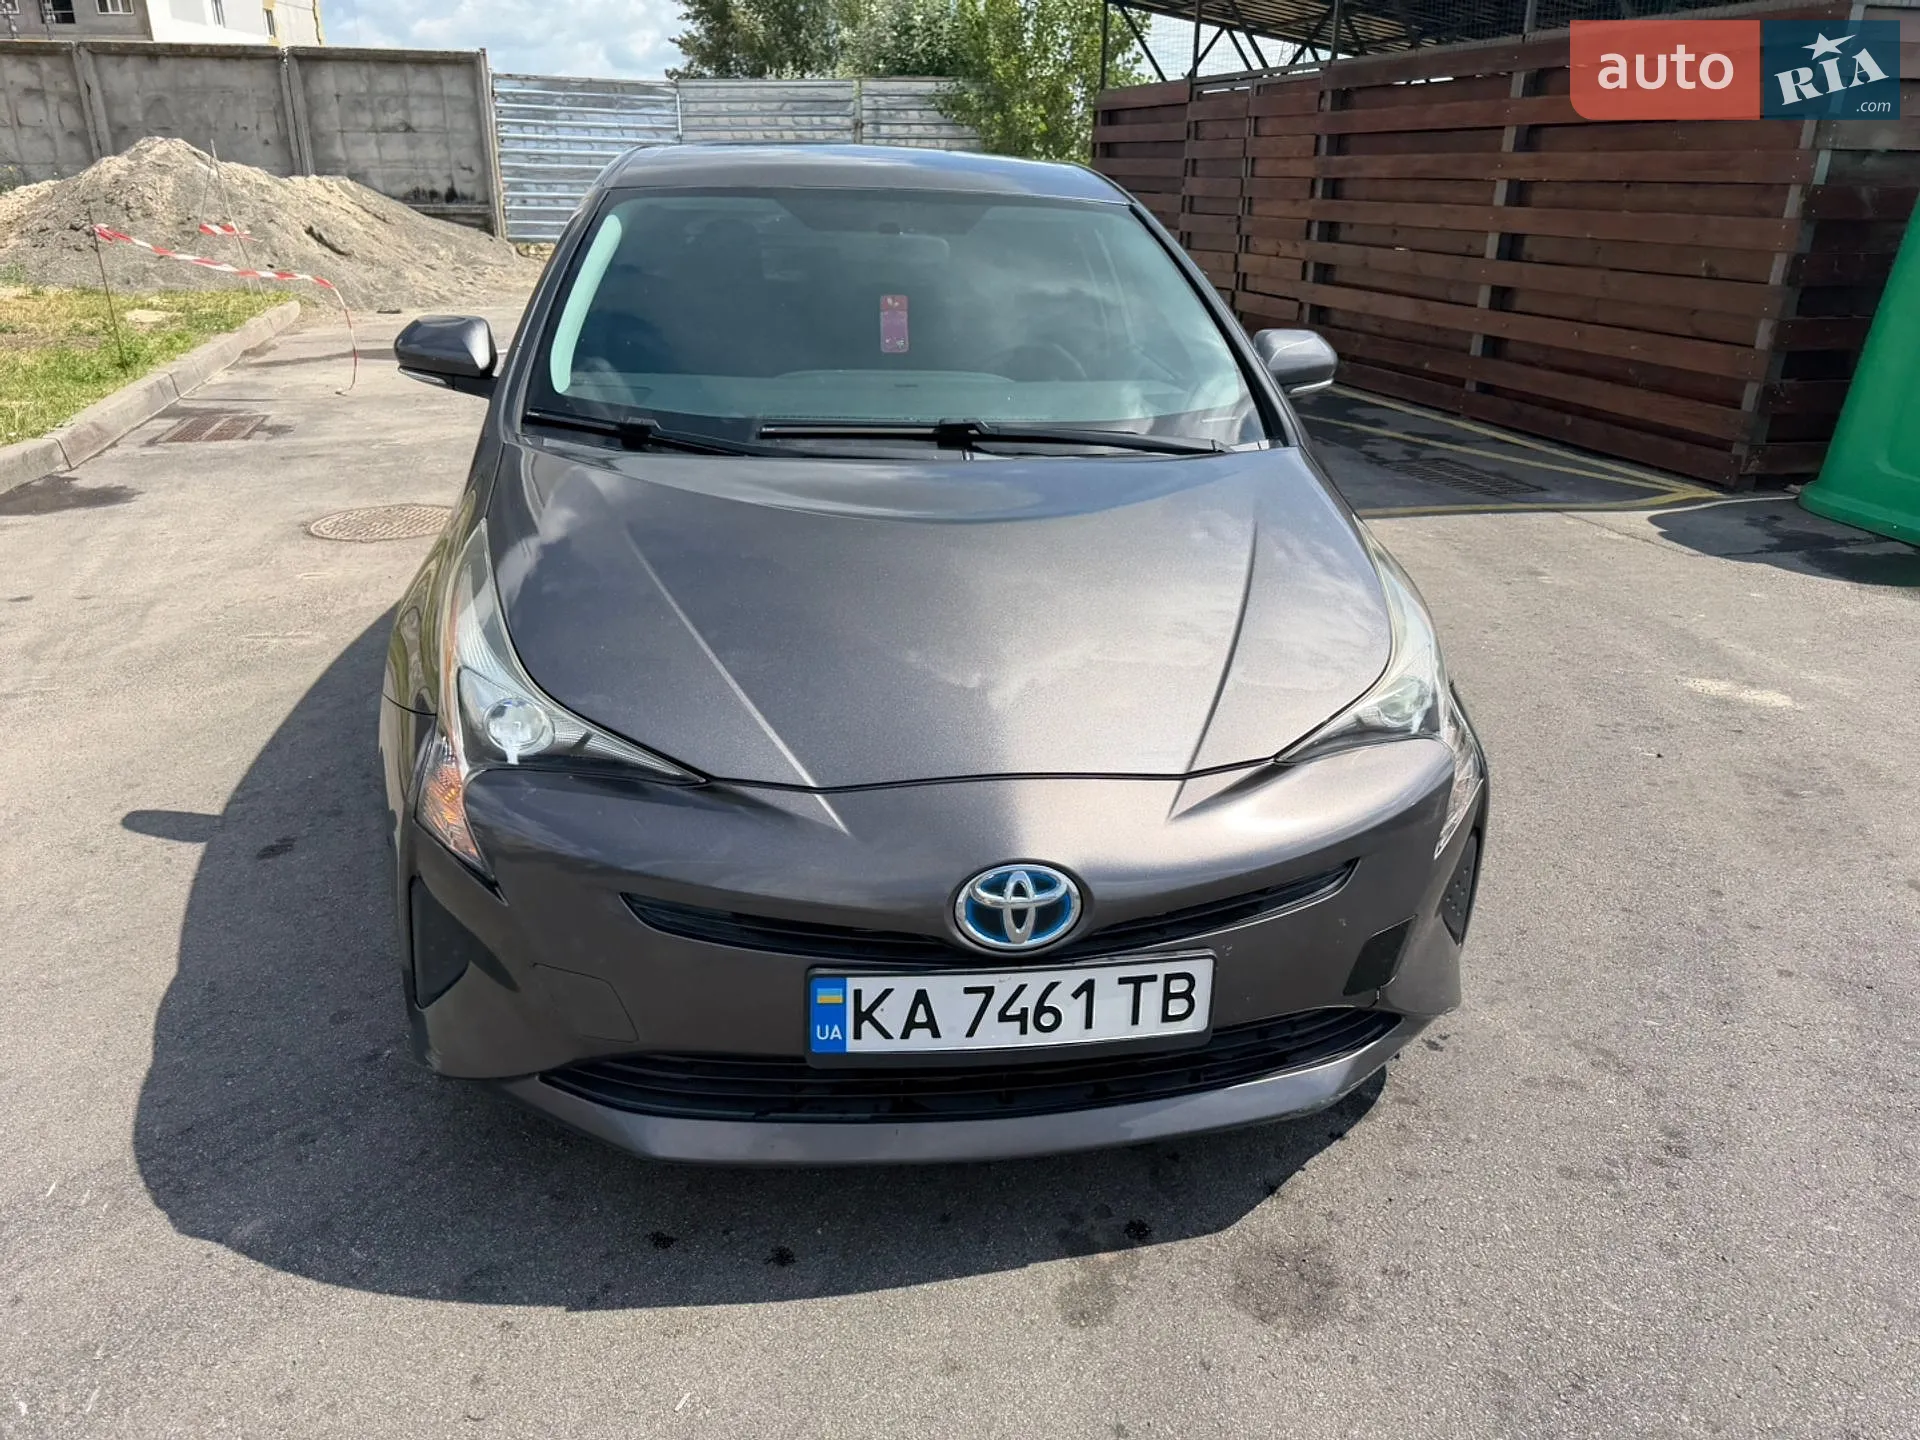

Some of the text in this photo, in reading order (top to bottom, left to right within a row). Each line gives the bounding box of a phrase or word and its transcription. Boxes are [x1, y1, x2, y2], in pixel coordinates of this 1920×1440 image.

[852, 971, 1197, 1041] KA 7461 TB
[816, 1024, 843, 1041] UA
